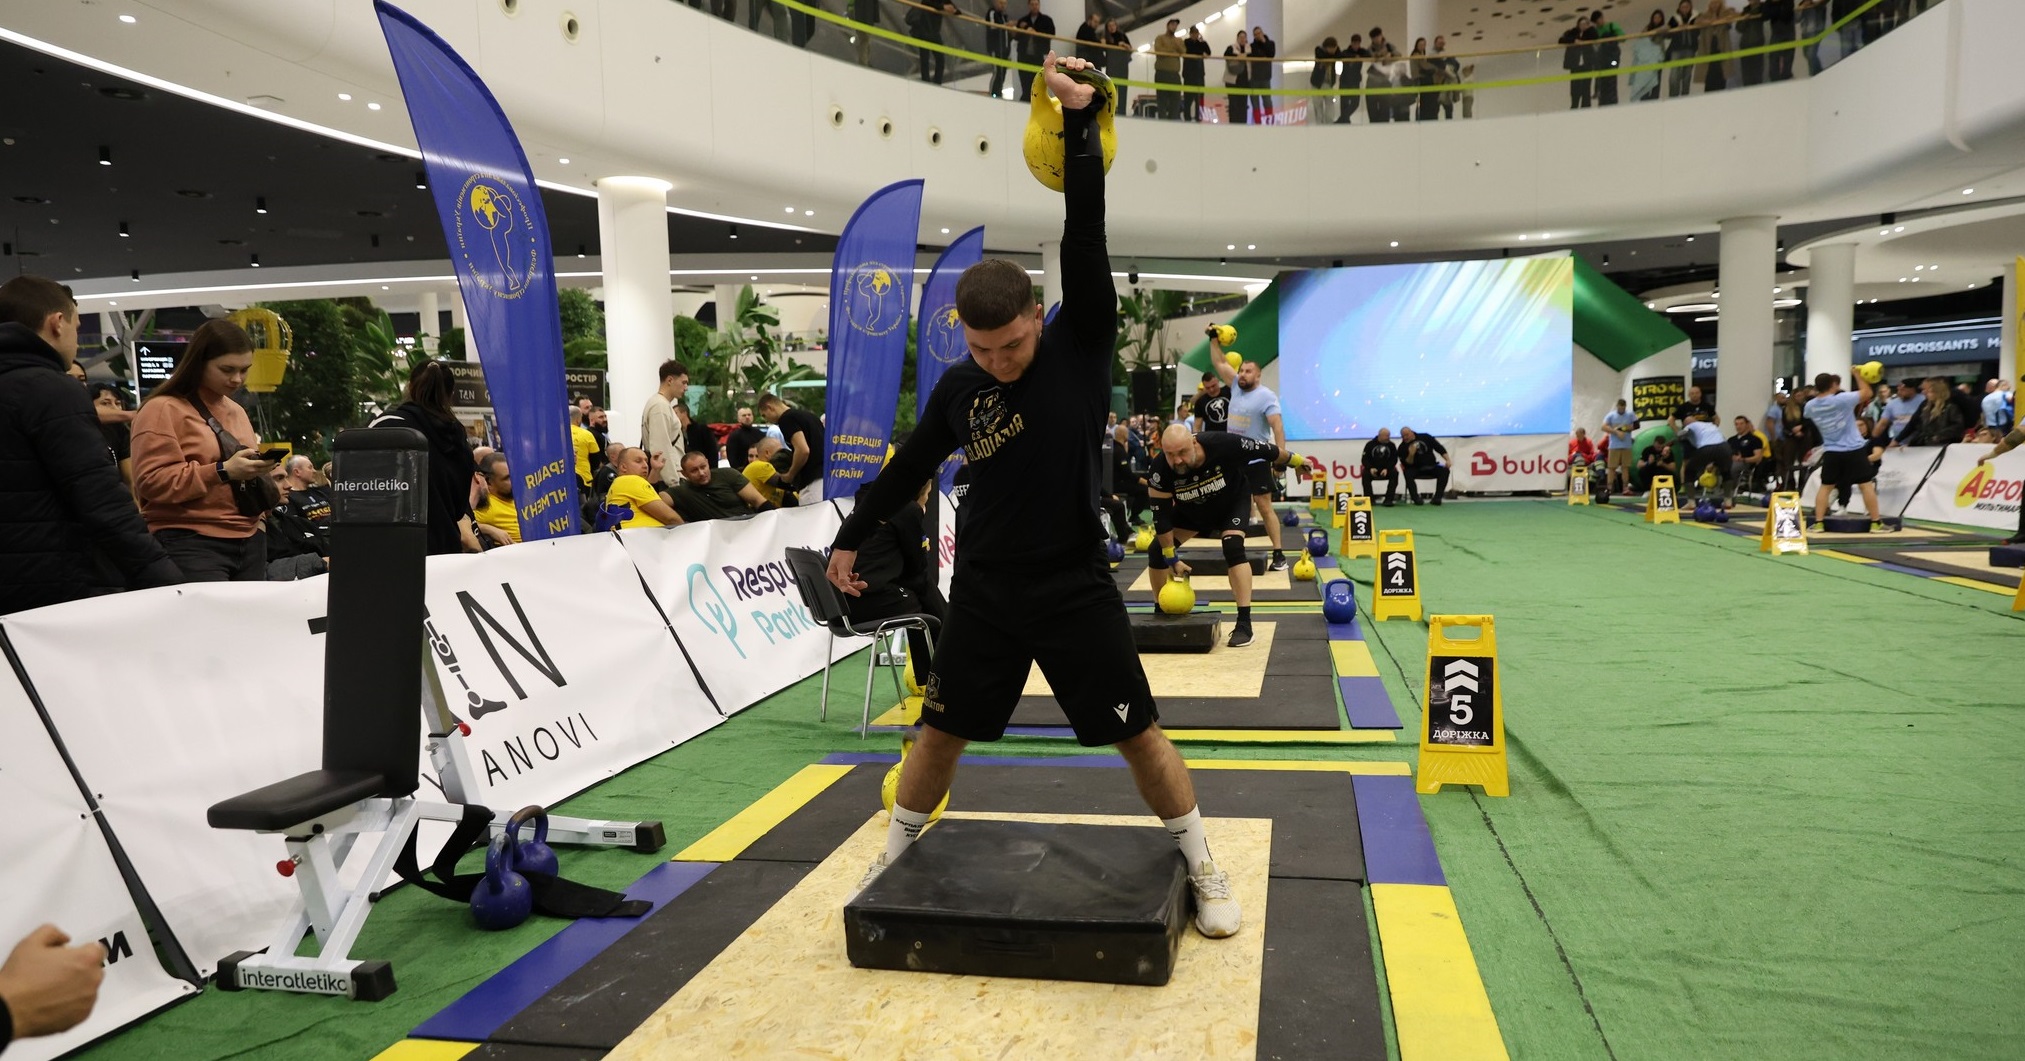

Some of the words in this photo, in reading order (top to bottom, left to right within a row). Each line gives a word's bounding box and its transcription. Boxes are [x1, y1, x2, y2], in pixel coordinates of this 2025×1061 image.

[1869, 343, 1897, 356] LVIV
[1897, 338, 1979, 355] CROISSANTS
[832, 434, 883, 448] ФЕДЕРАЦІЯ
[830, 451, 884, 464] СТРОНГМЕНУ
[334, 478, 410, 492] interatletika
[1959, 470, 2024, 501] АВРО
[1340, 501, 1348, 511] 2
[1658, 497, 1673, 507] 10
[1357, 523, 1366, 535] 3
[1390, 570, 1405, 586] 4
[751, 599, 817, 645] Park
[1449, 694, 1474, 726] 5
[1432, 729, 1490, 740] ДОРІЖКА
